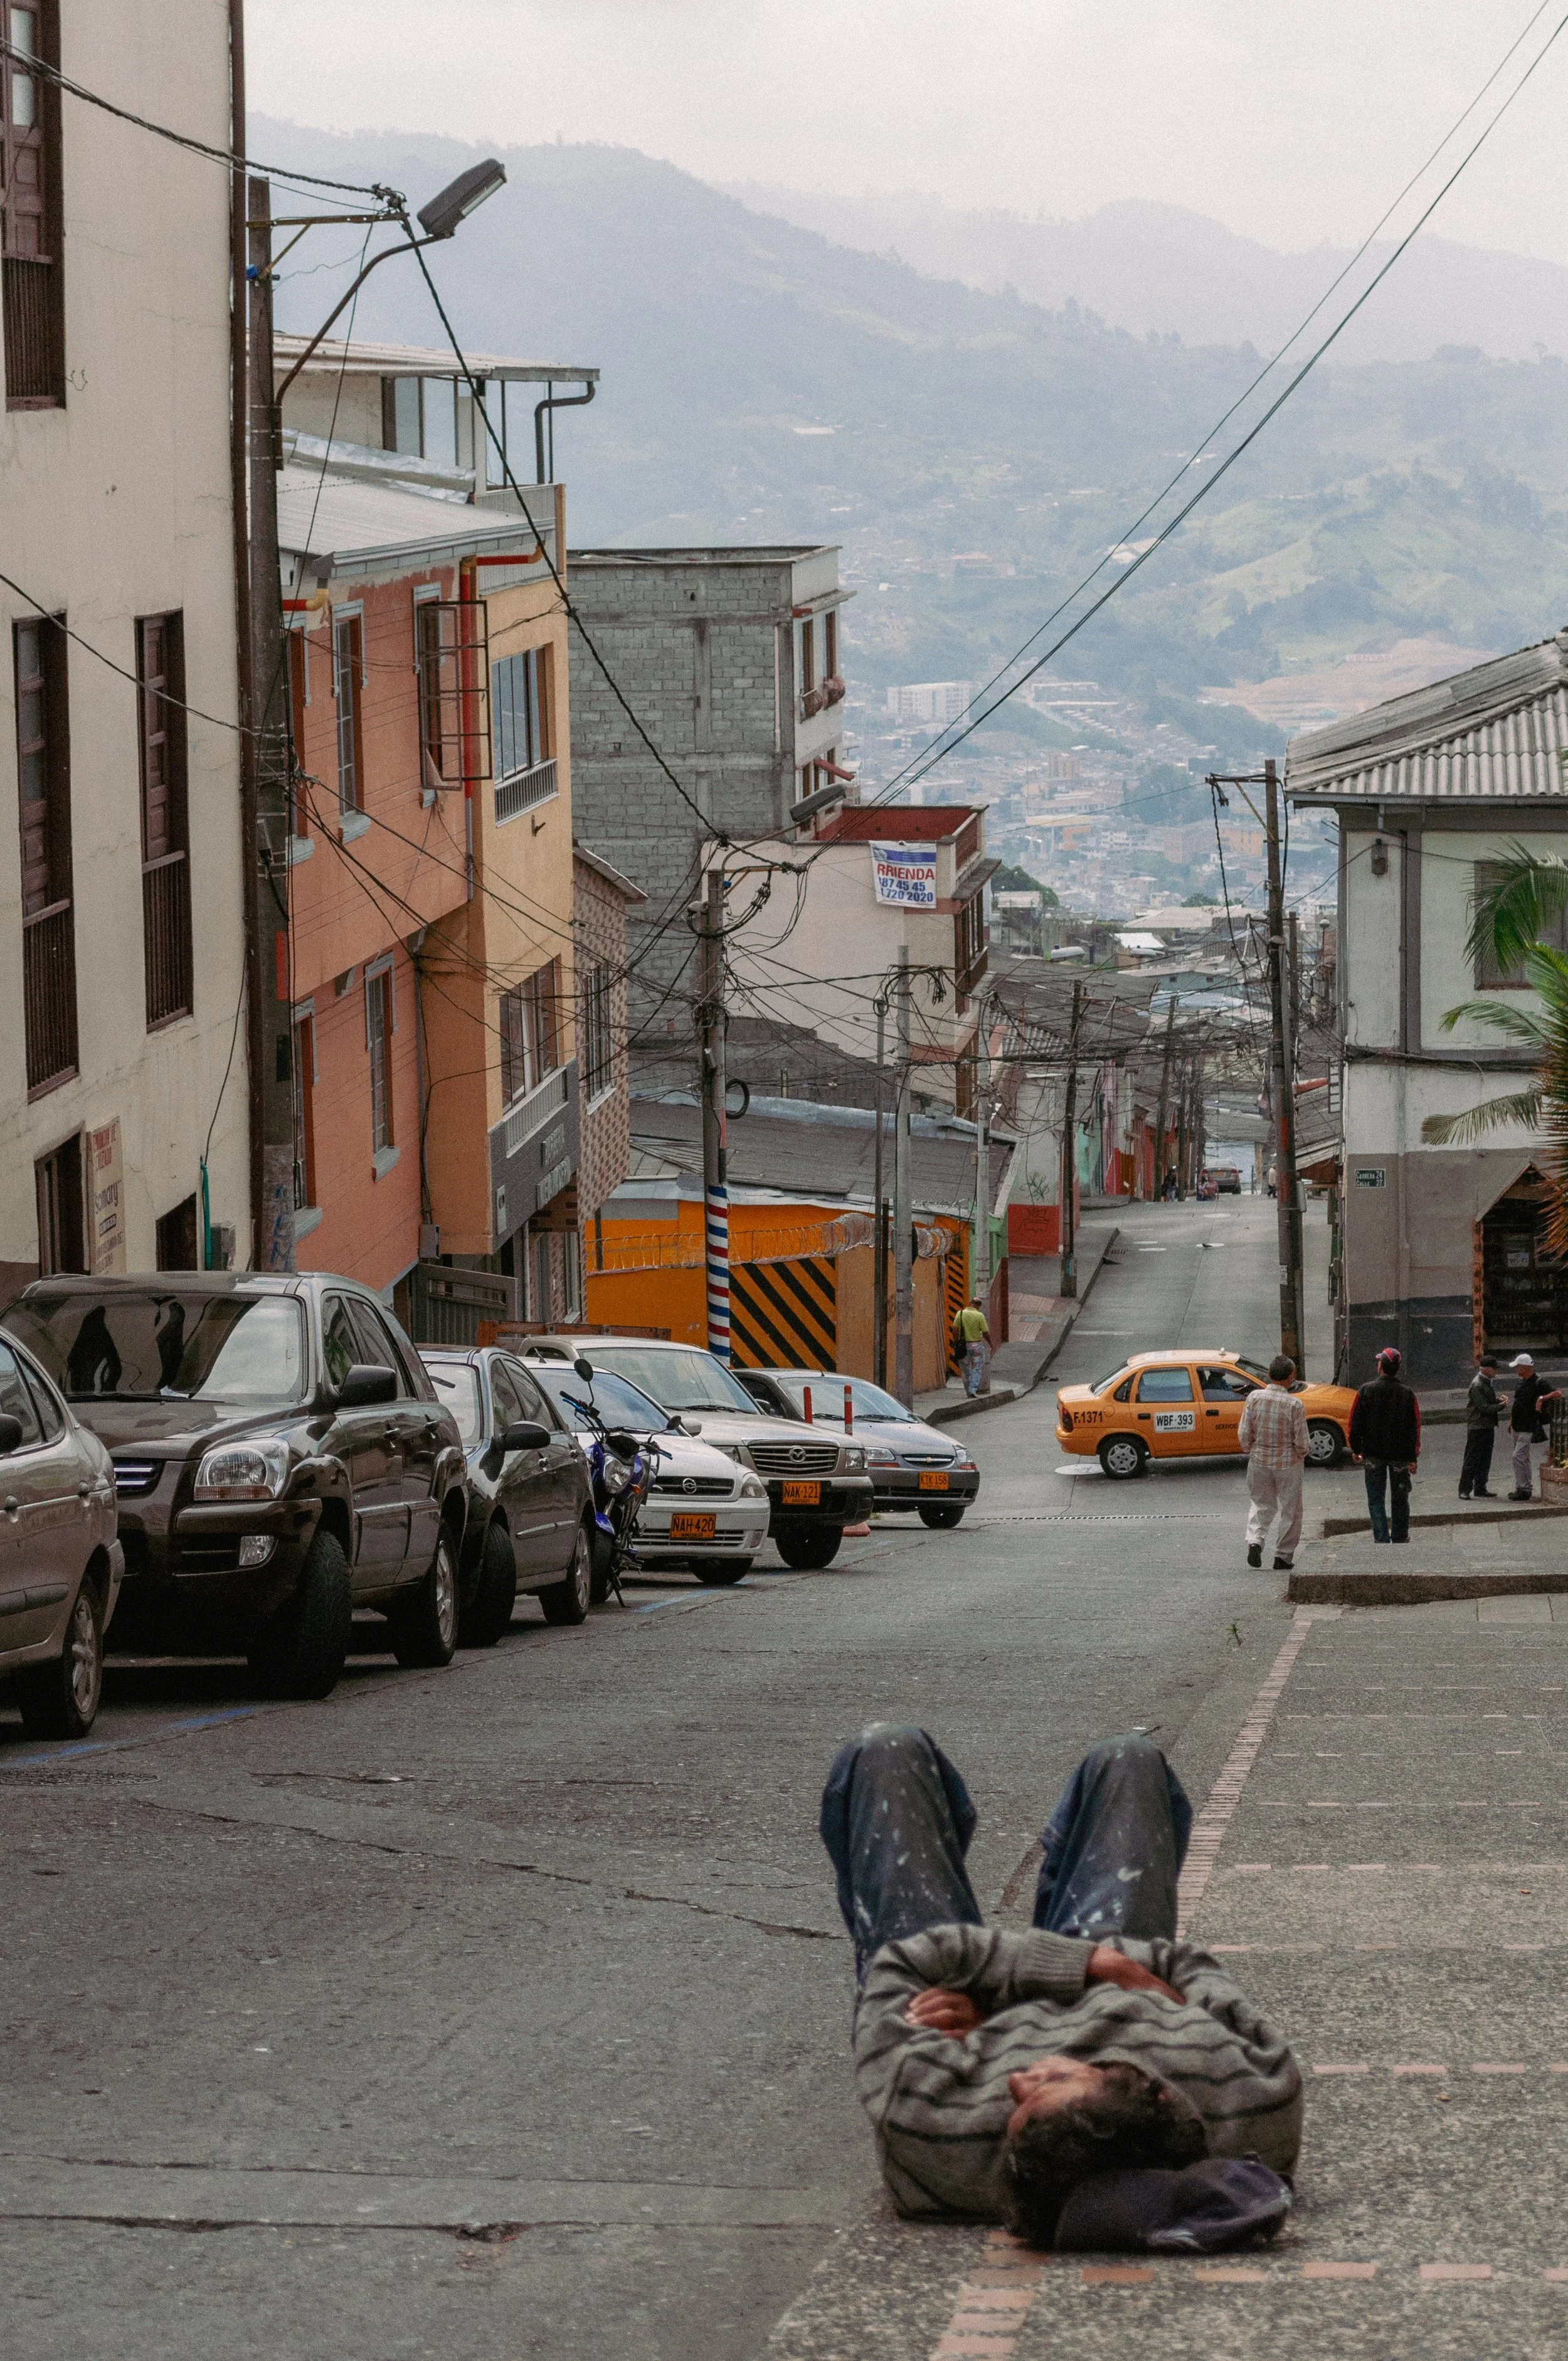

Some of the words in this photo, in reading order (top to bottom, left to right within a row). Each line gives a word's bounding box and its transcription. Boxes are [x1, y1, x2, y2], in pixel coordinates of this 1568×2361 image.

[896, 880, 909, 891] 45
[912, 882, 926, 892] 45
[887, 888, 904, 899] 720
[907, 892, 933, 902] 2020
[1376, 1170, 1383, 1179] 24
[1074, 1411, 1103, 1423] F.1371
